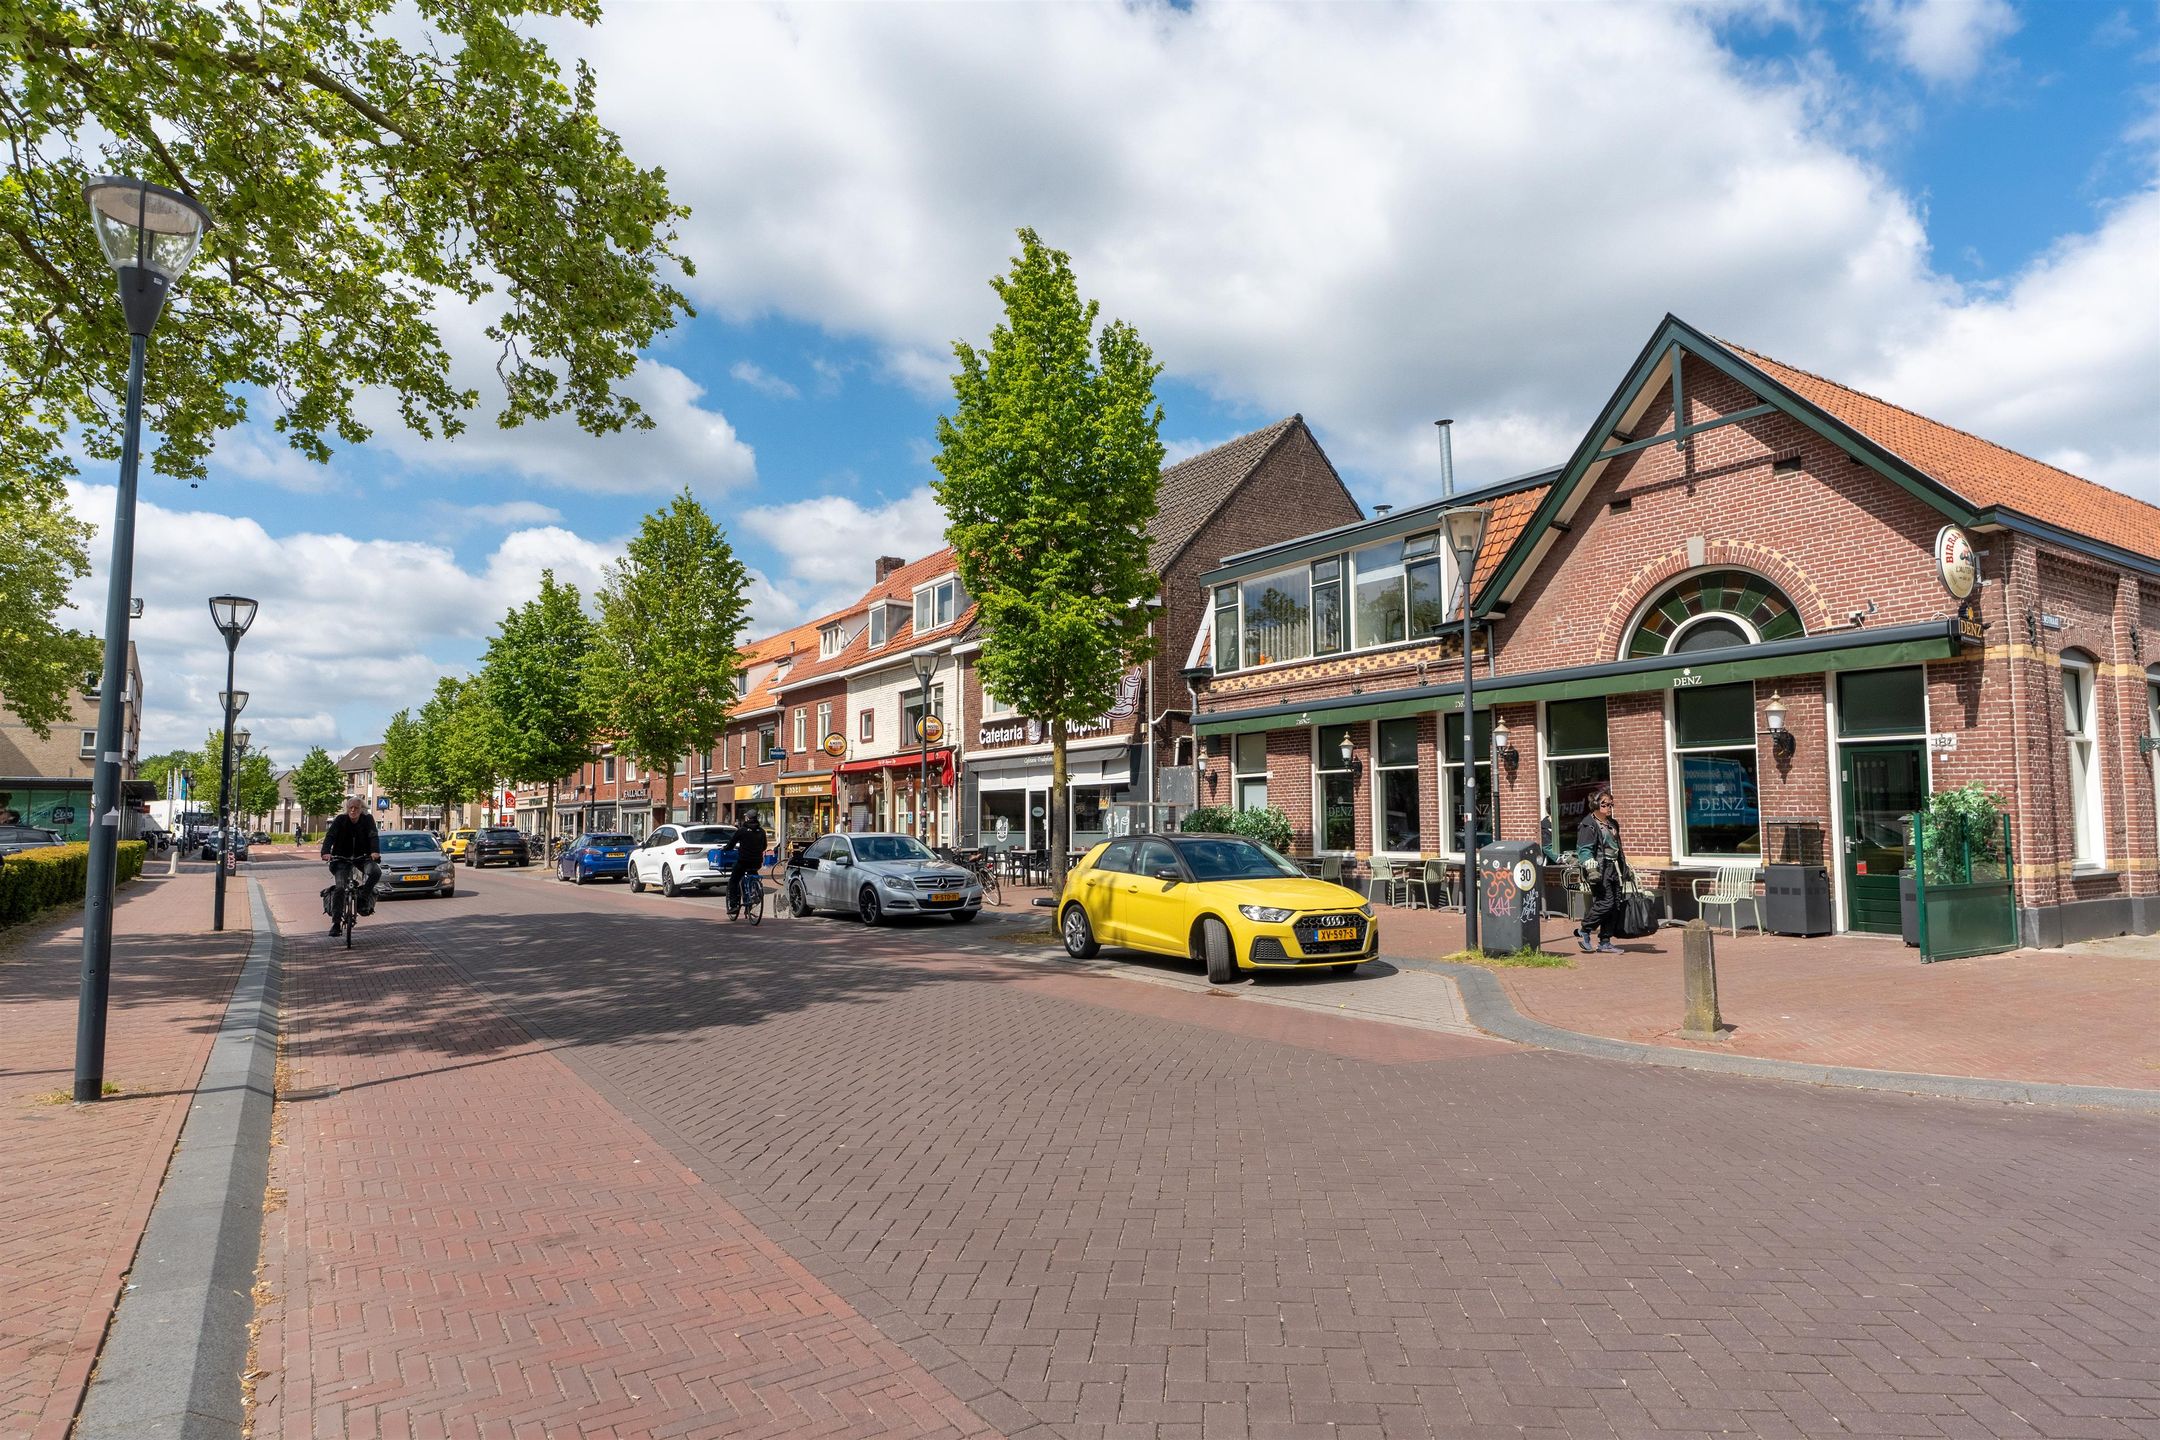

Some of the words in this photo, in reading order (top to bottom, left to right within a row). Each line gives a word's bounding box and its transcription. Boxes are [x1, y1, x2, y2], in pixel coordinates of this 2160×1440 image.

[1961, 620, 1982, 638] DENZ
[1673, 675, 1702, 687] DENZ
[979, 724, 1024, 745] Cafetaria
[1699, 797, 1745, 811] DENZ
[1328, 806, 1354, 817] DENZ
[1519, 868, 1531, 882] 30
[1321, 928, 1355, 940] XV-597-S
